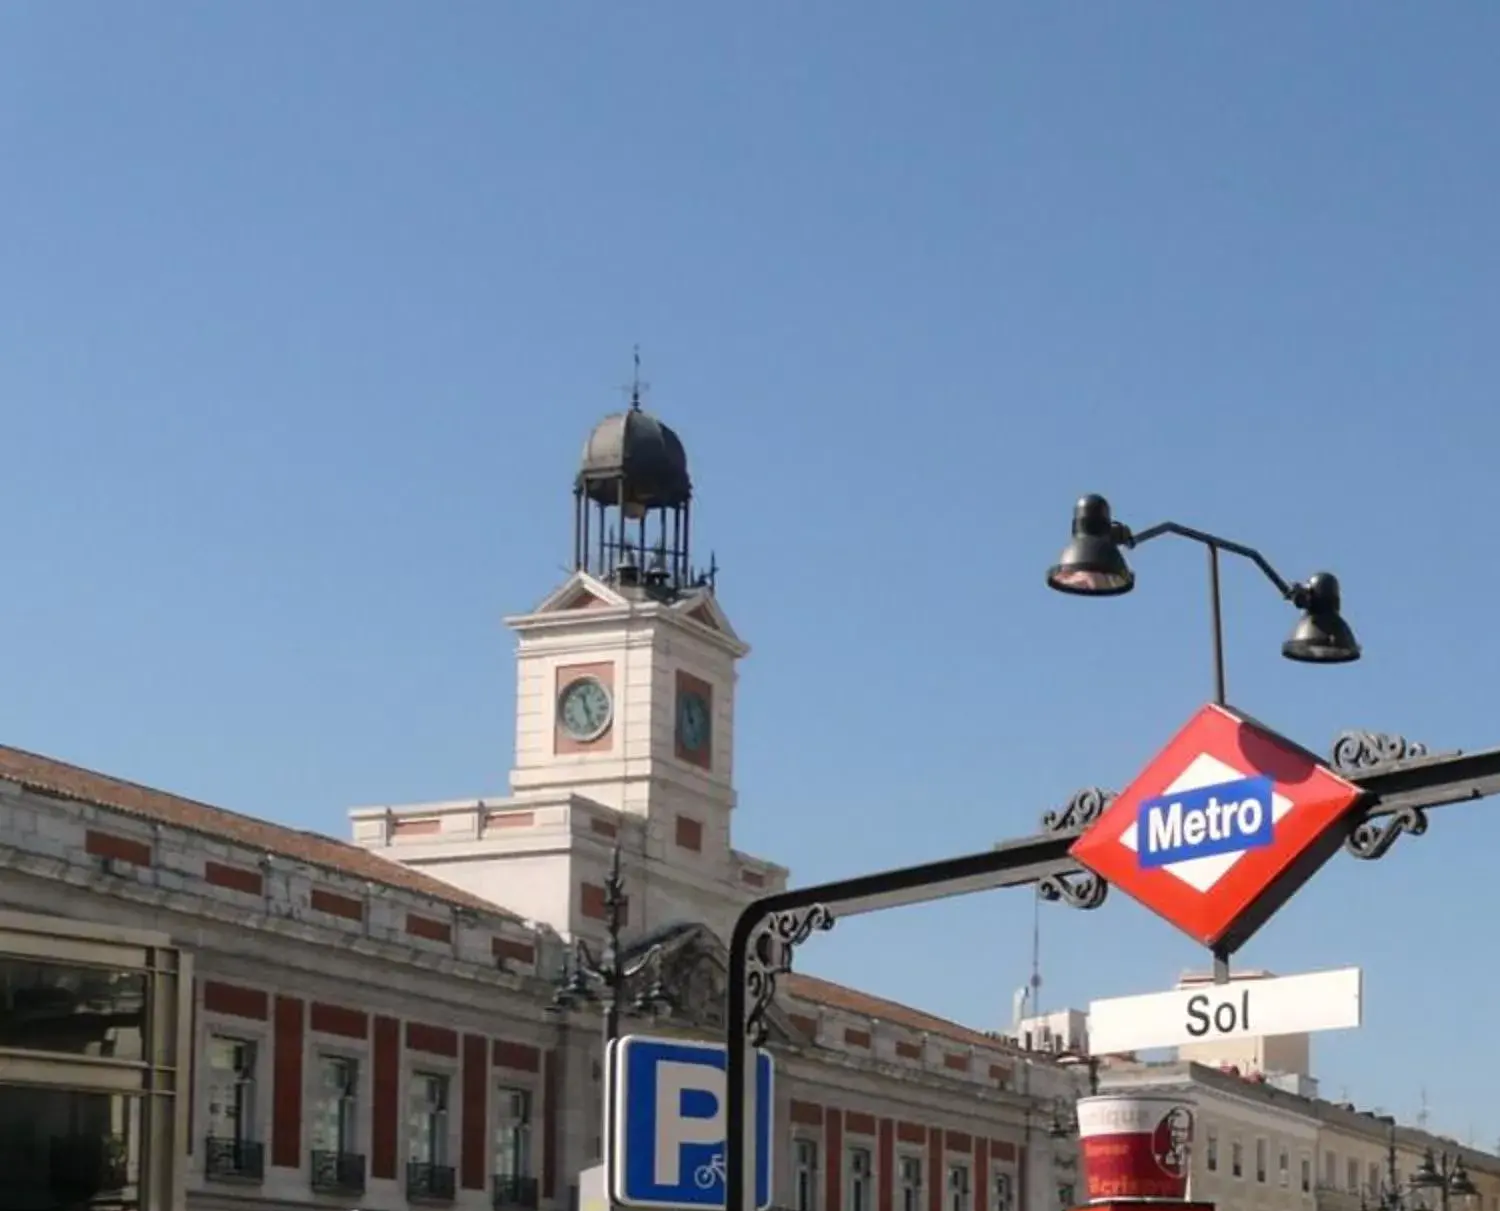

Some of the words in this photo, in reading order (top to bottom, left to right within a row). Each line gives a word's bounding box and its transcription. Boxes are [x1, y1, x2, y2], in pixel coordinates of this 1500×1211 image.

[1149, 797, 1263, 853] Metro
[1186, 990, 1250, 1037] Sol
[654, 1059, 727, 1186] P
